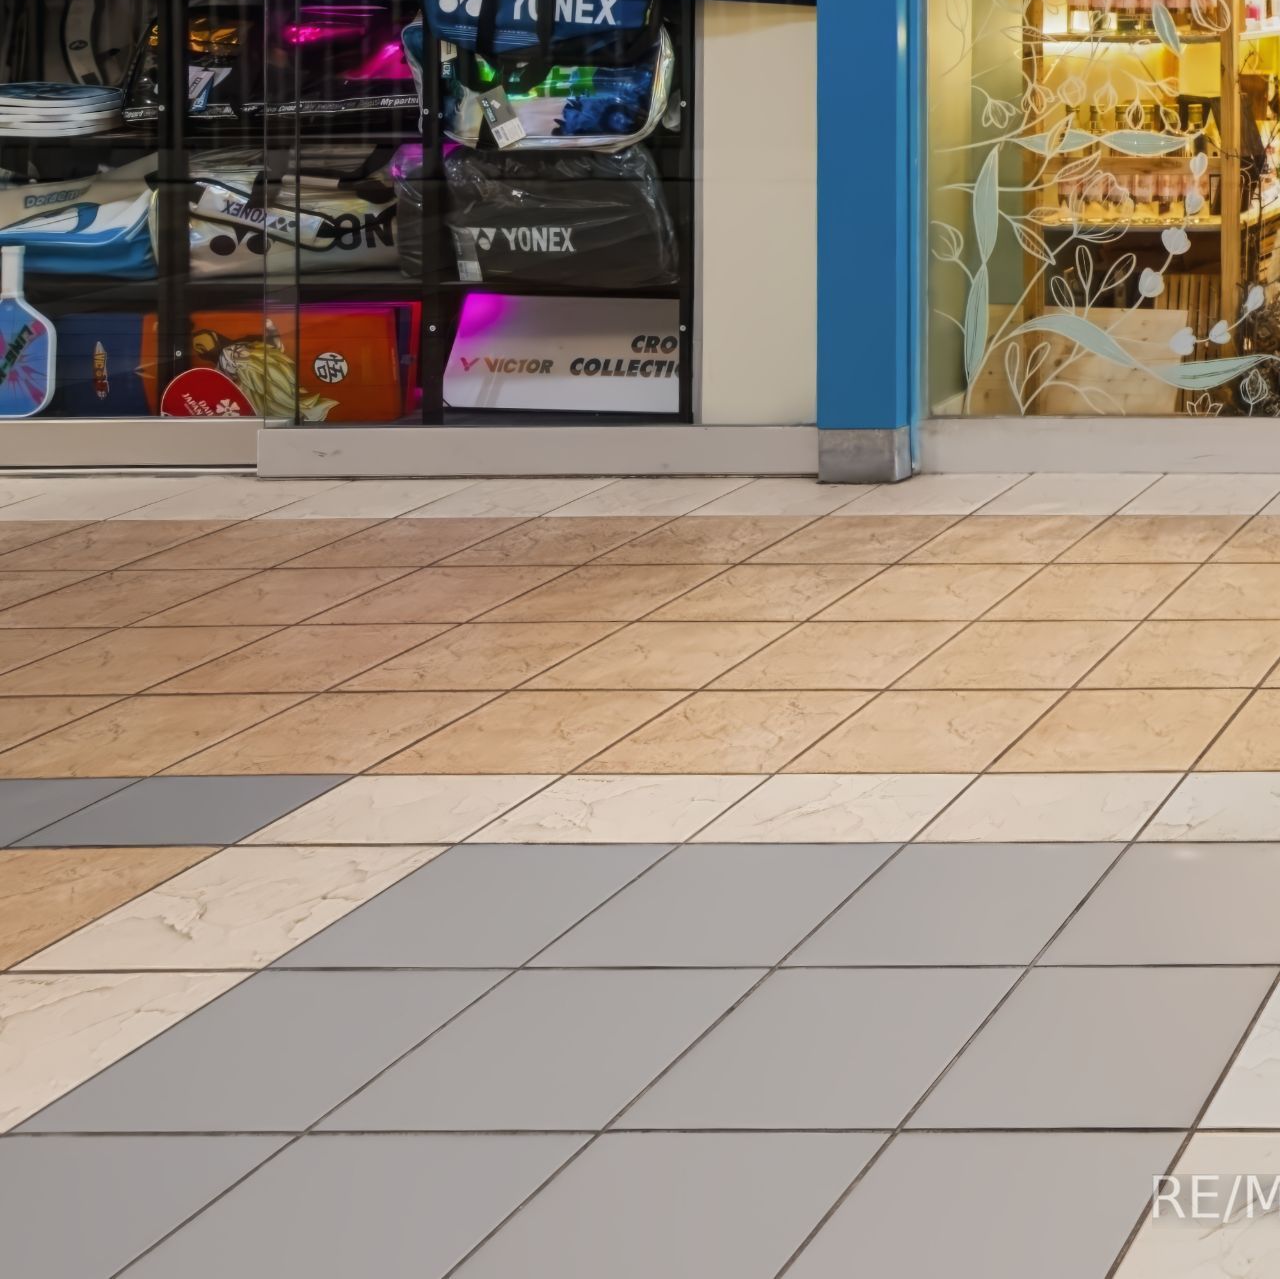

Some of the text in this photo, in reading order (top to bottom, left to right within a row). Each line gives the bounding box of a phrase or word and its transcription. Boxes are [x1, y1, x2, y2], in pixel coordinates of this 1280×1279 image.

[394, 96, 418, 106] partn
[222, 199, 267, 225] YONEX
[502, 227, 574, 252] YONEX
[485, 358, 553, 375] VICTOR
